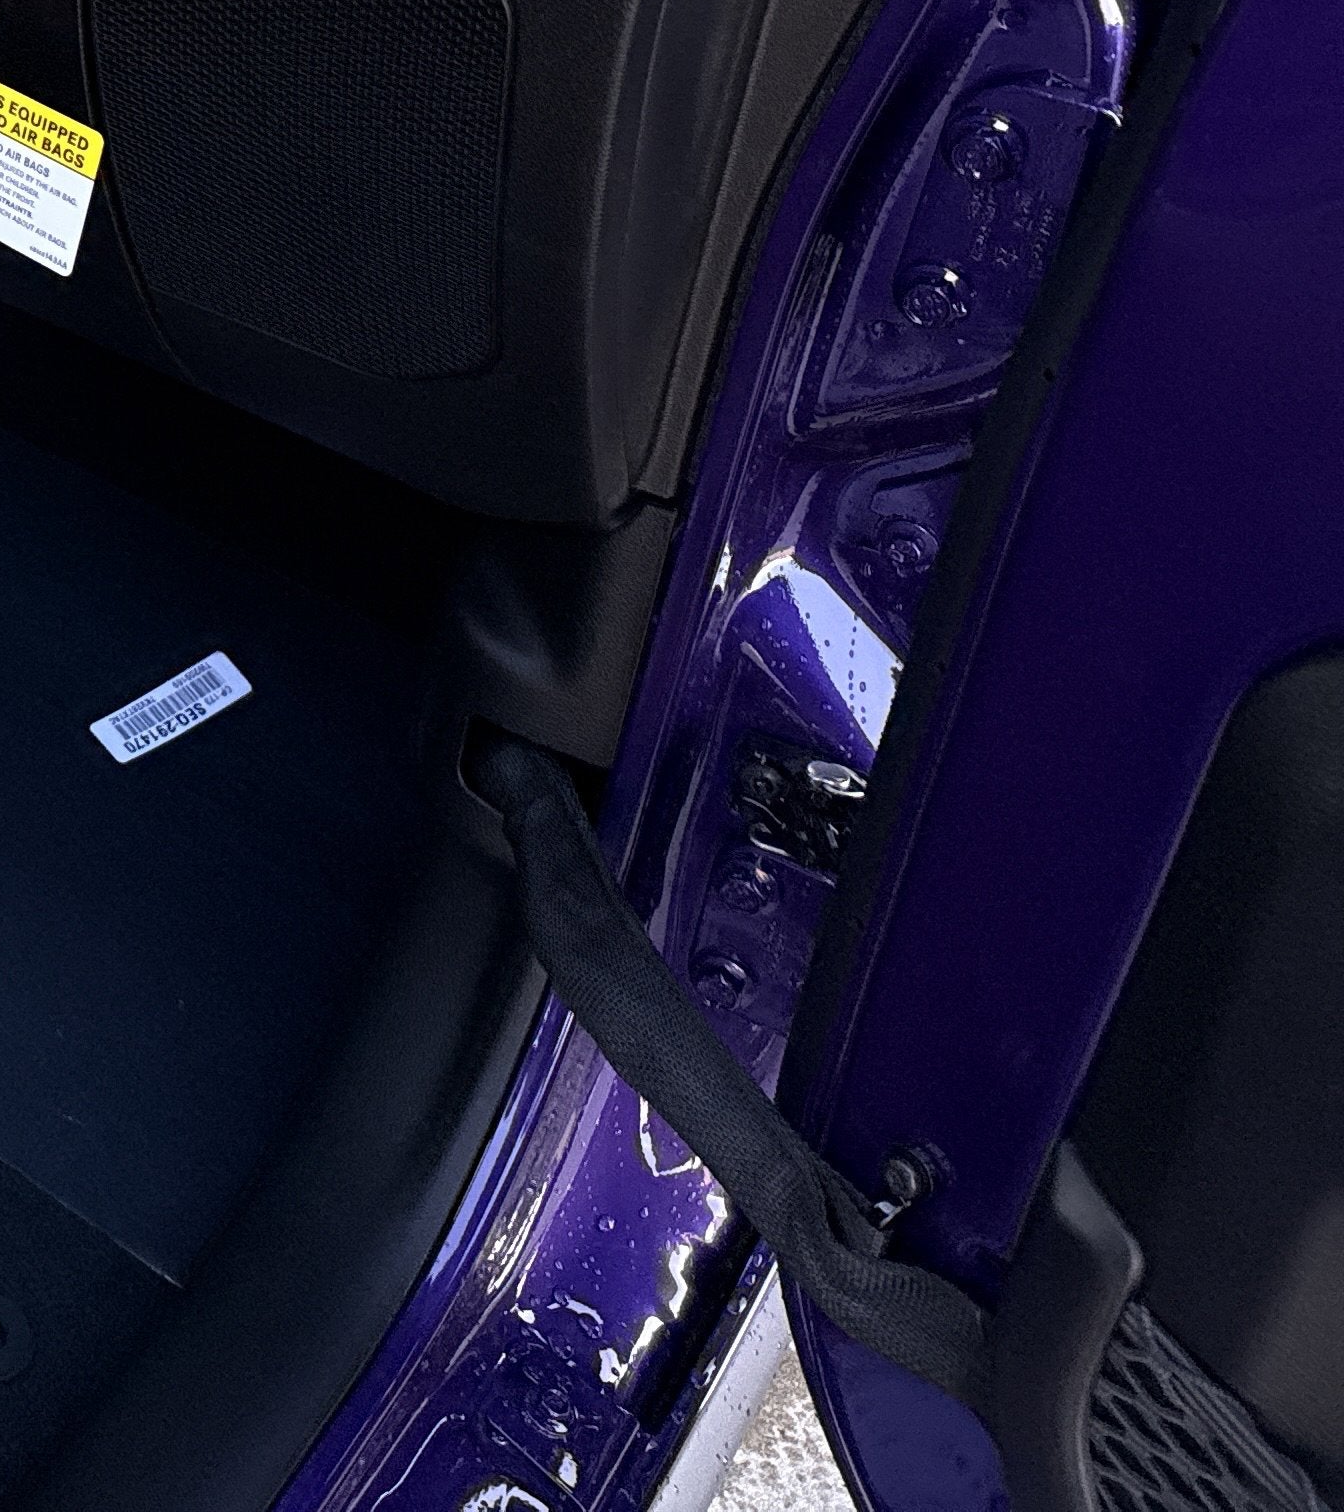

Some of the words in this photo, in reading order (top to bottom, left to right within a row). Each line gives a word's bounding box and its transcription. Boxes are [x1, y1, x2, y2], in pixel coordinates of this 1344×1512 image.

[8, 101, 90, 151] EQUIPPED
[10, 120, 39, 145] AIR
[41, 136, 86, 168] BAGS
[5, 147, 22, 162] AIR
[23, 156, 51, 177] BAGS
[0, 183, 11, 194] THE
[35, 179, 48, 190] THE
[12, 214, 35, 231] ABOUT
